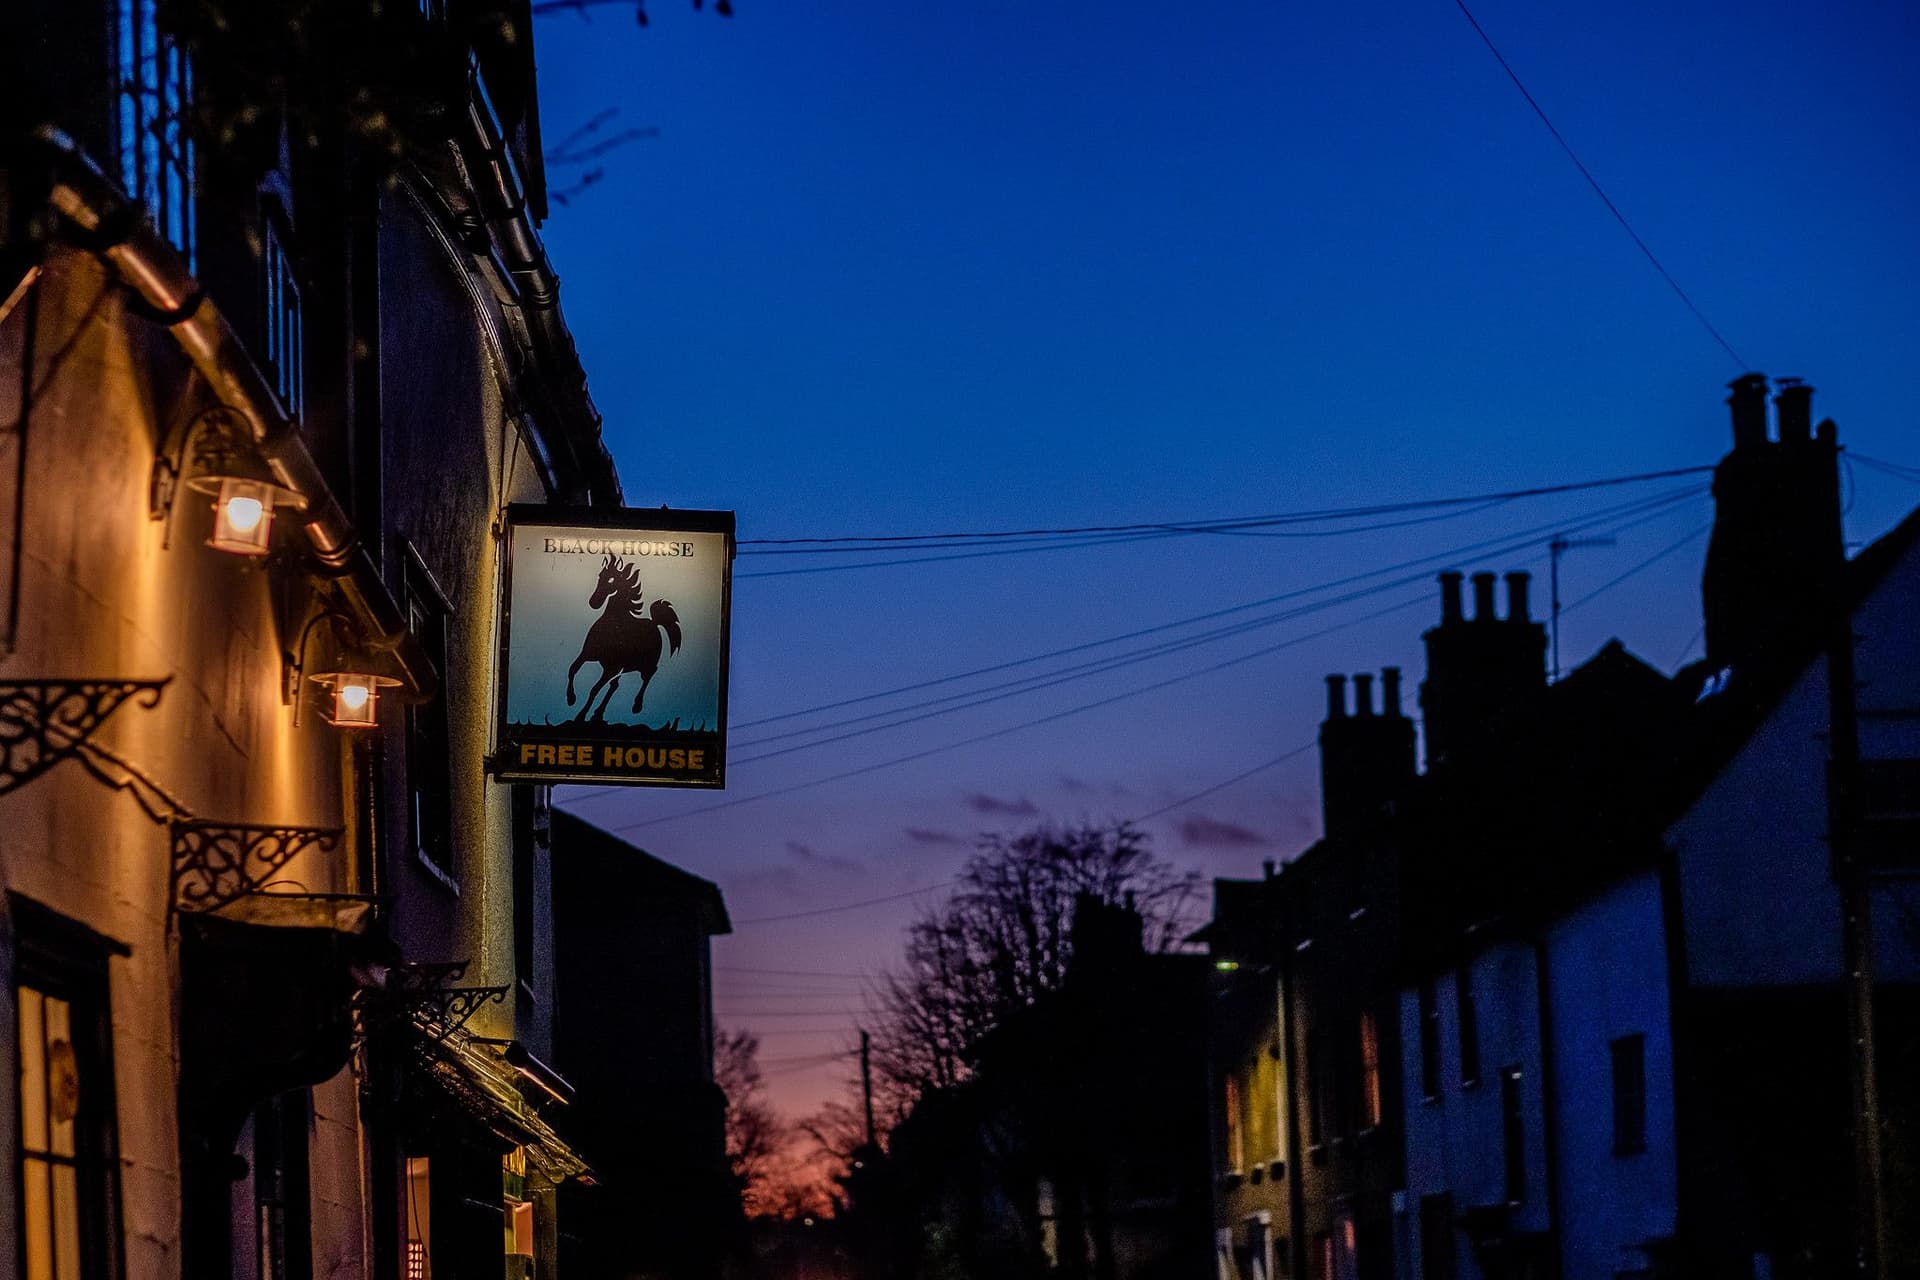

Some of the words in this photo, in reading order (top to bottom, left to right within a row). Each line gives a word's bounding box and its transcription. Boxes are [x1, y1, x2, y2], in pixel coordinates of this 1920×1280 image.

[543, 538, 614, 555] BLACK
[622, 541, 694, 557] HORSE
[520, 743, 594, 766] FREE
[603, 746, 704, 769] HOUSE
